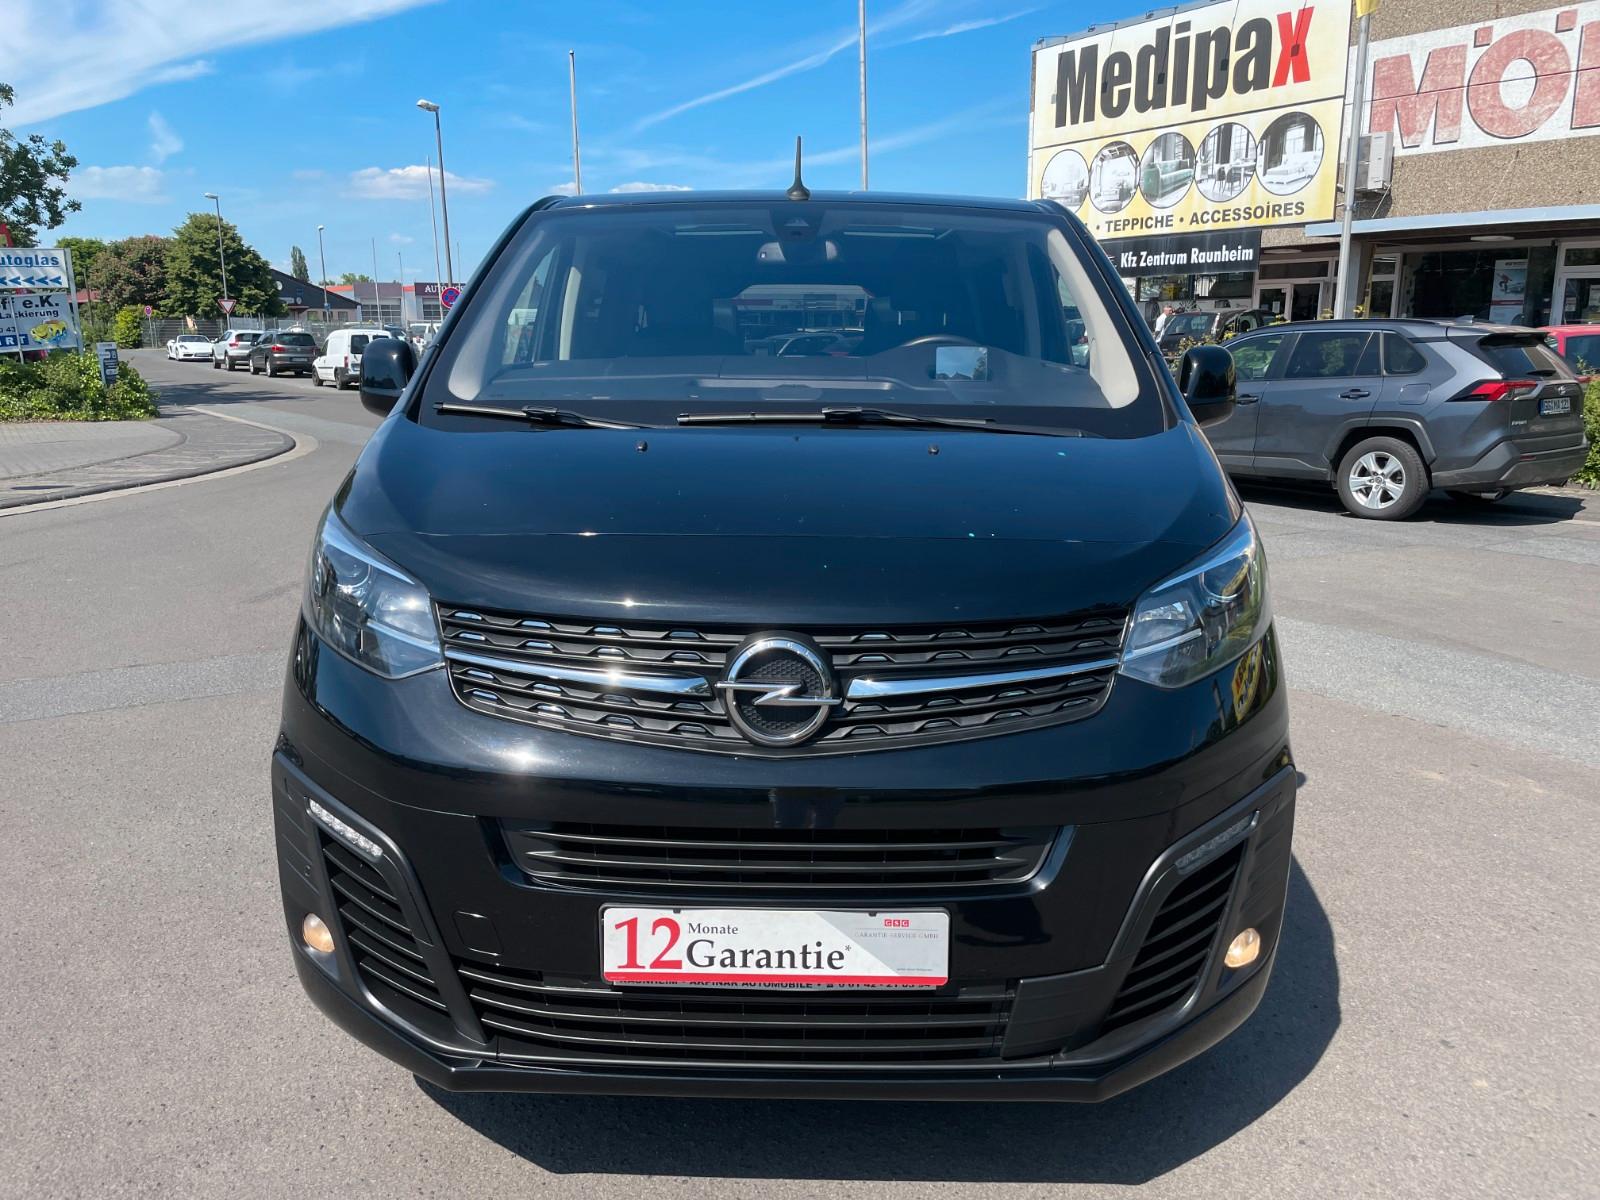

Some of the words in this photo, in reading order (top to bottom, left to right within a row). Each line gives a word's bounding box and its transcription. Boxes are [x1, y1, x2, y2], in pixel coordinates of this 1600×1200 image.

[1055, 6, 1315, 128] Medipax
[1105, 214, 1174, 233] TEPPICHE
[1120, 251, 1138, 268] Kfz
[1140, 251, 1187, 267] Zentrum
[1190, 244, 1254, 264] Raunheim
[22, 294, 60, 309] e.K.
[614, 917, 683, 970] 12
[688, 922, 739, 935] Monate
